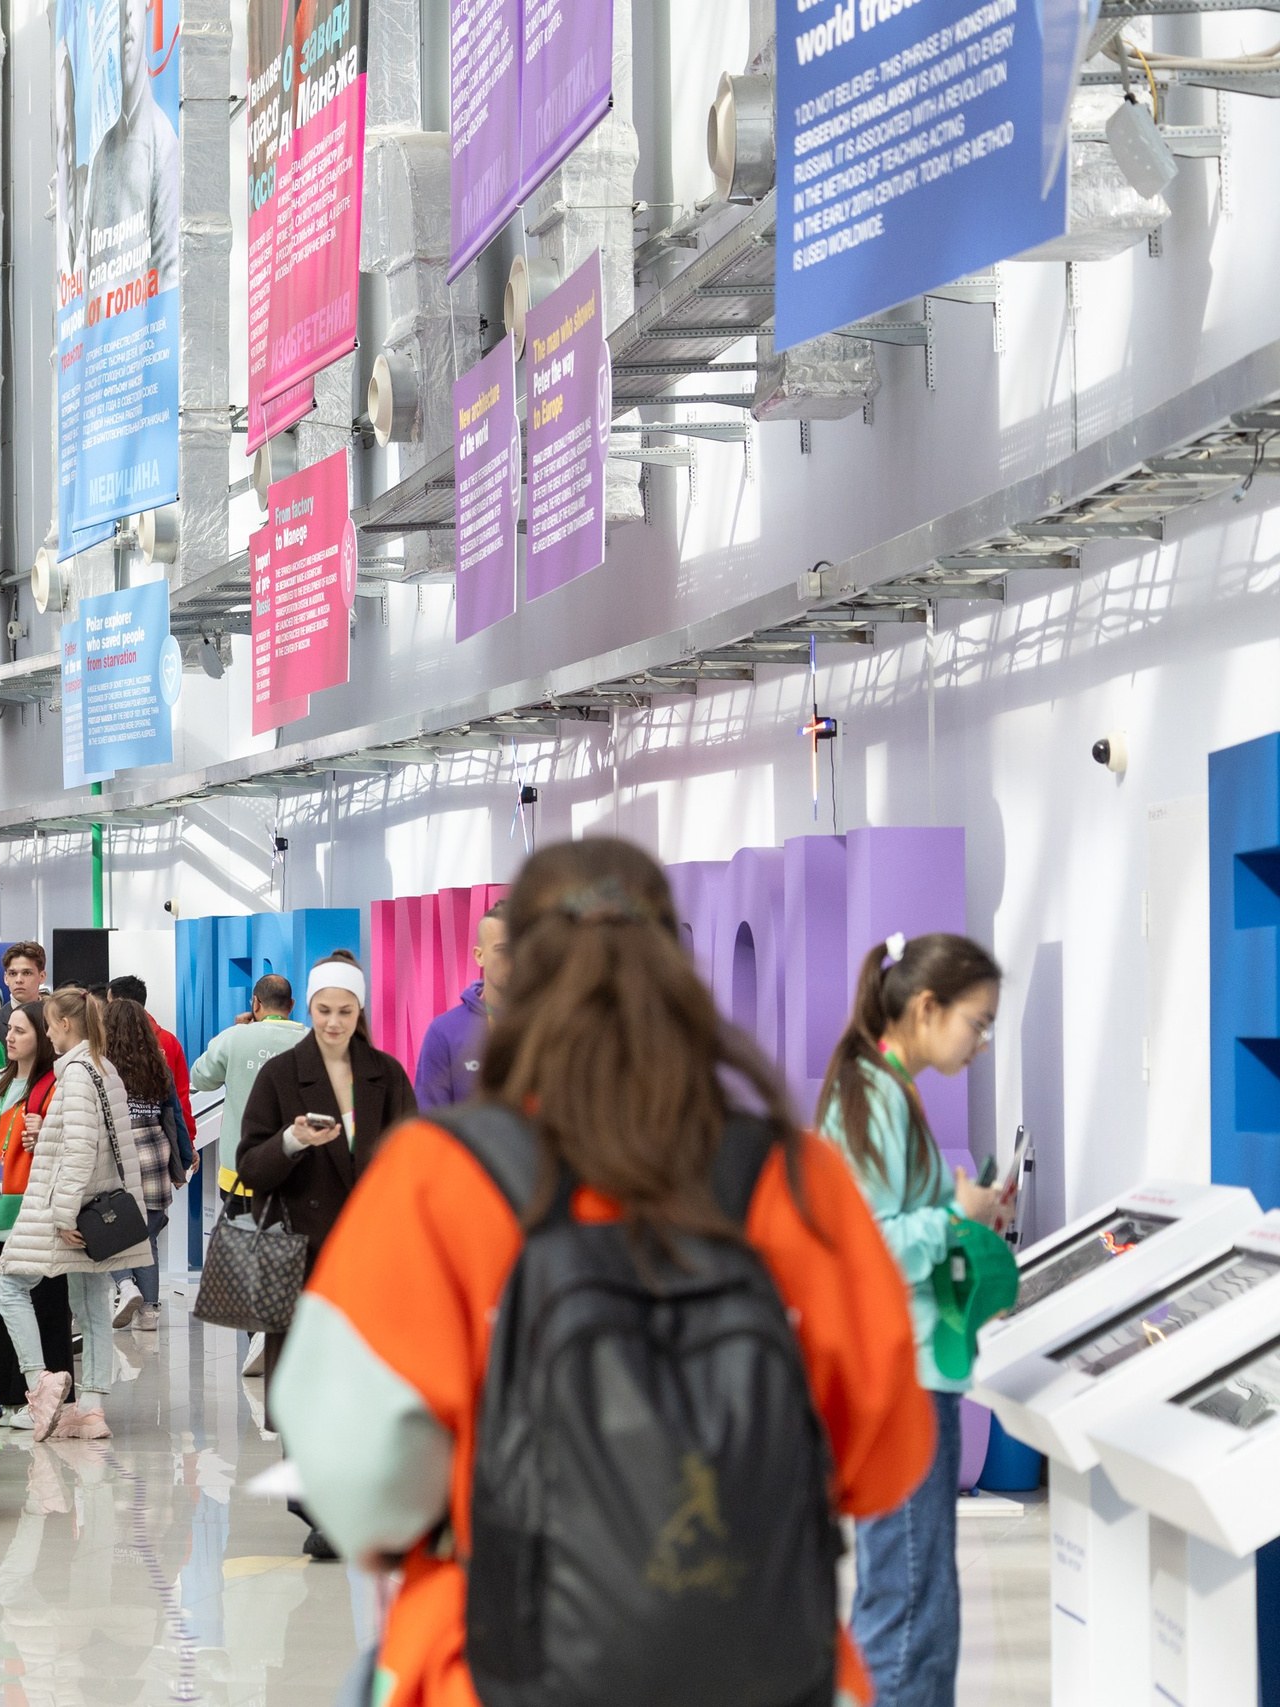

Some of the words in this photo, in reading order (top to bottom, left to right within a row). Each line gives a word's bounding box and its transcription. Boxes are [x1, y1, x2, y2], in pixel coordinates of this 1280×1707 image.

[299, 0, 350, 76] завода
[901, 33, 940, 73] PHRASE
[929, 49, 966, 89] KNOWN
[981, 22, 1015, 61] EVERY
[296, 43, 357, 129] Манежа
[535, 46, 596, 153] ПОЛИТИКА
[855, 110, 912, 157] ASSOCIATED
[912, 96, 937, 128] WITH
[945, 59, 1007, 112] REVOLUTION
[248, 94, 279, 163] красо
[804, 182, 823, 208] THE
[823, 161, 867, 202] METHODS
[881, 131, 929, 173] TEACHING
[929, 113, 965, 151] ACTING
[804, 211, 822, 238] THE
[822, 198, 851, 231] EARLY
[971, 120, 1015, 161] METHOD
[803, 238, 828, 268] USED
[61, 267, 83, 307] Отец
[87, 295, 101, 328] от
[105, 266, 158, 318] голода
[271, 290, 350, 374] ИЗОБРЕТЕНИЯ
[532, 336, 545, 364] The
[546, 327, 559, 355] man
[560, 314, 573, 344] who
[573, 290, 595, 333] showed
[533, 367, 550, 398] Peter
[551, 357, 561, 386] the
[562, 349, 574, 378] way
[459, 407, 470, 431] New
[471, 383, 500, 423] architecture
[533, 405, 540, 430] to
[541, 392, 563, 425] Europe
[474, 417, 488, 449] world
[89, 458, 160, 507] МЕДИЦИНА
[274, 505, 290, 526] From
[291, 495, 314, 519] factory
[274, 531, 282, 551] to
[282, 524, 307, 548] Manege
[86, 616, 103, 634] Polar
[104, 611, 132, 631] explorer
[86, 637, 100, 653] who
[101, 633, 120, 649] saved
[122, 627, 145, 647] people
[86, 656, 102, 672] from
[103, 650, 137, 669] starvation
